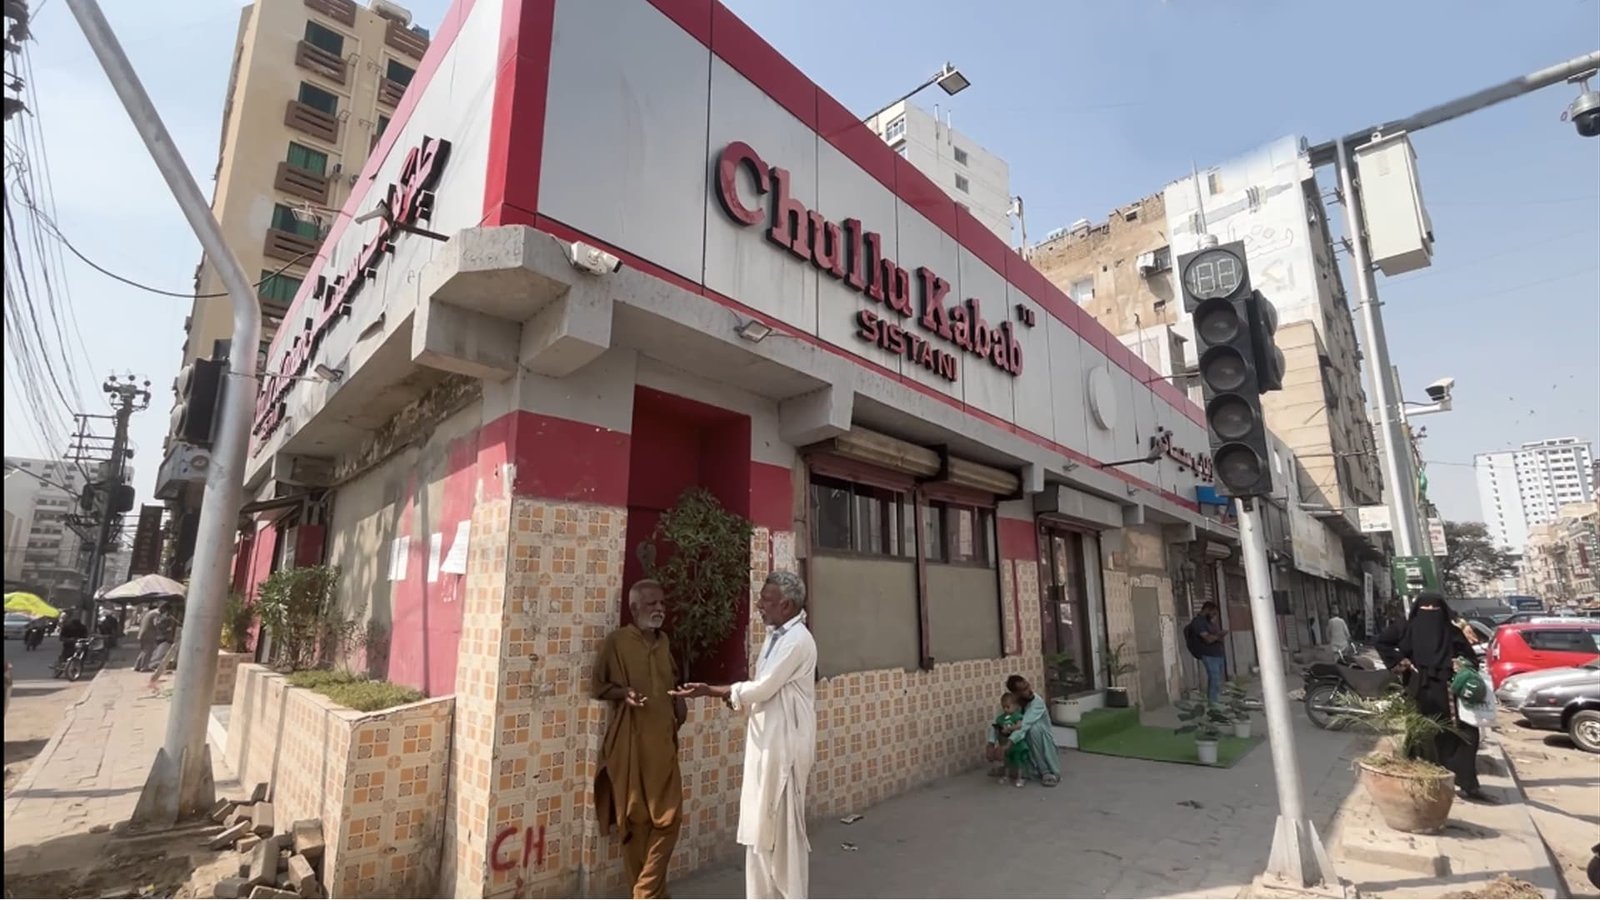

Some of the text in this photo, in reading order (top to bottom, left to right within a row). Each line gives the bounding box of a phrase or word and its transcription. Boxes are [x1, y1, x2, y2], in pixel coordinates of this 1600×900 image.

[717, 141, 912, 318] Chullu
[918, 266, 1024, 377] Kabab
[856, 308, 957, 382] SISTANI
